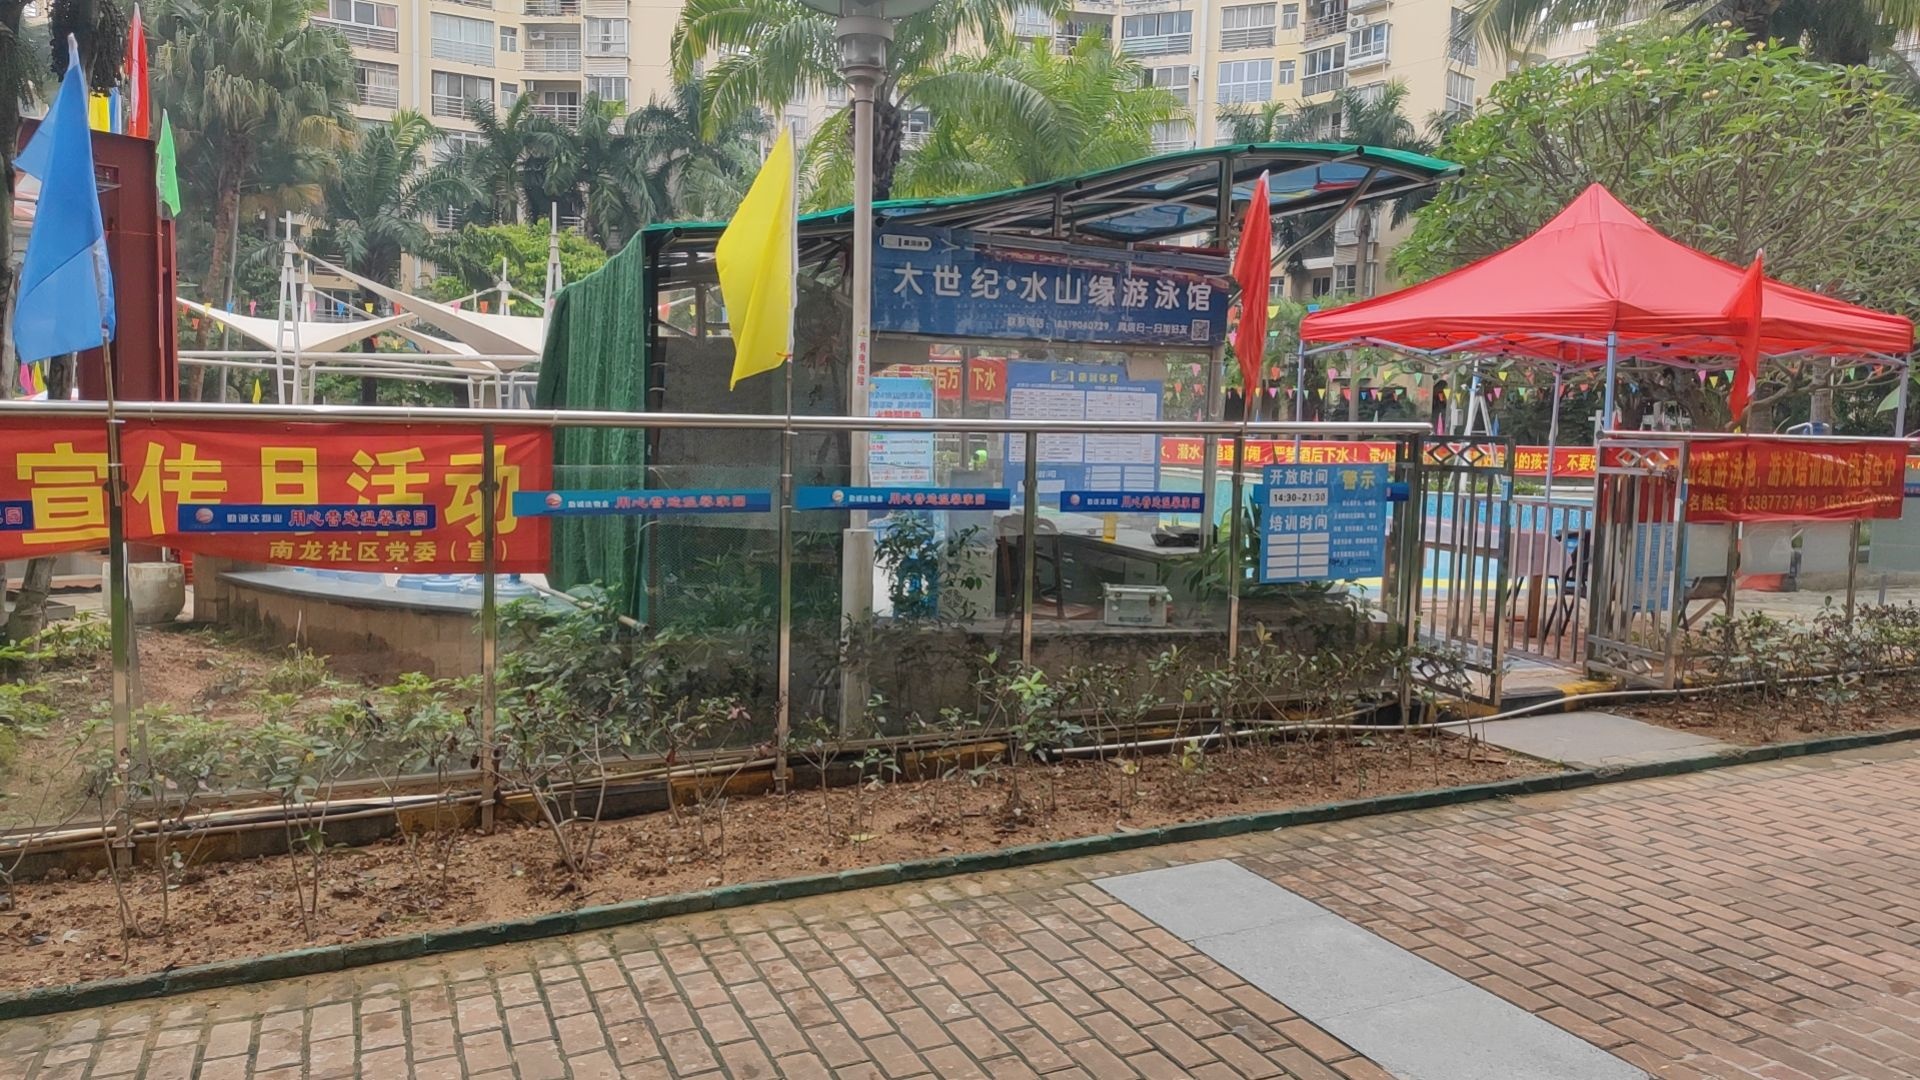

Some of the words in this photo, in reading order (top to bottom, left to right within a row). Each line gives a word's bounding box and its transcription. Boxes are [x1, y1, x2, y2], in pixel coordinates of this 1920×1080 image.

[1269, 469, 1328, 486] 开放时间
[1341, 469, 1376, 491] 警示
[16, 441, 520, 544] 宣传日活动
[1273, 492, 1326, 503] 14:30-21:30
[1269, 514, 1328, 532] 培训时间
